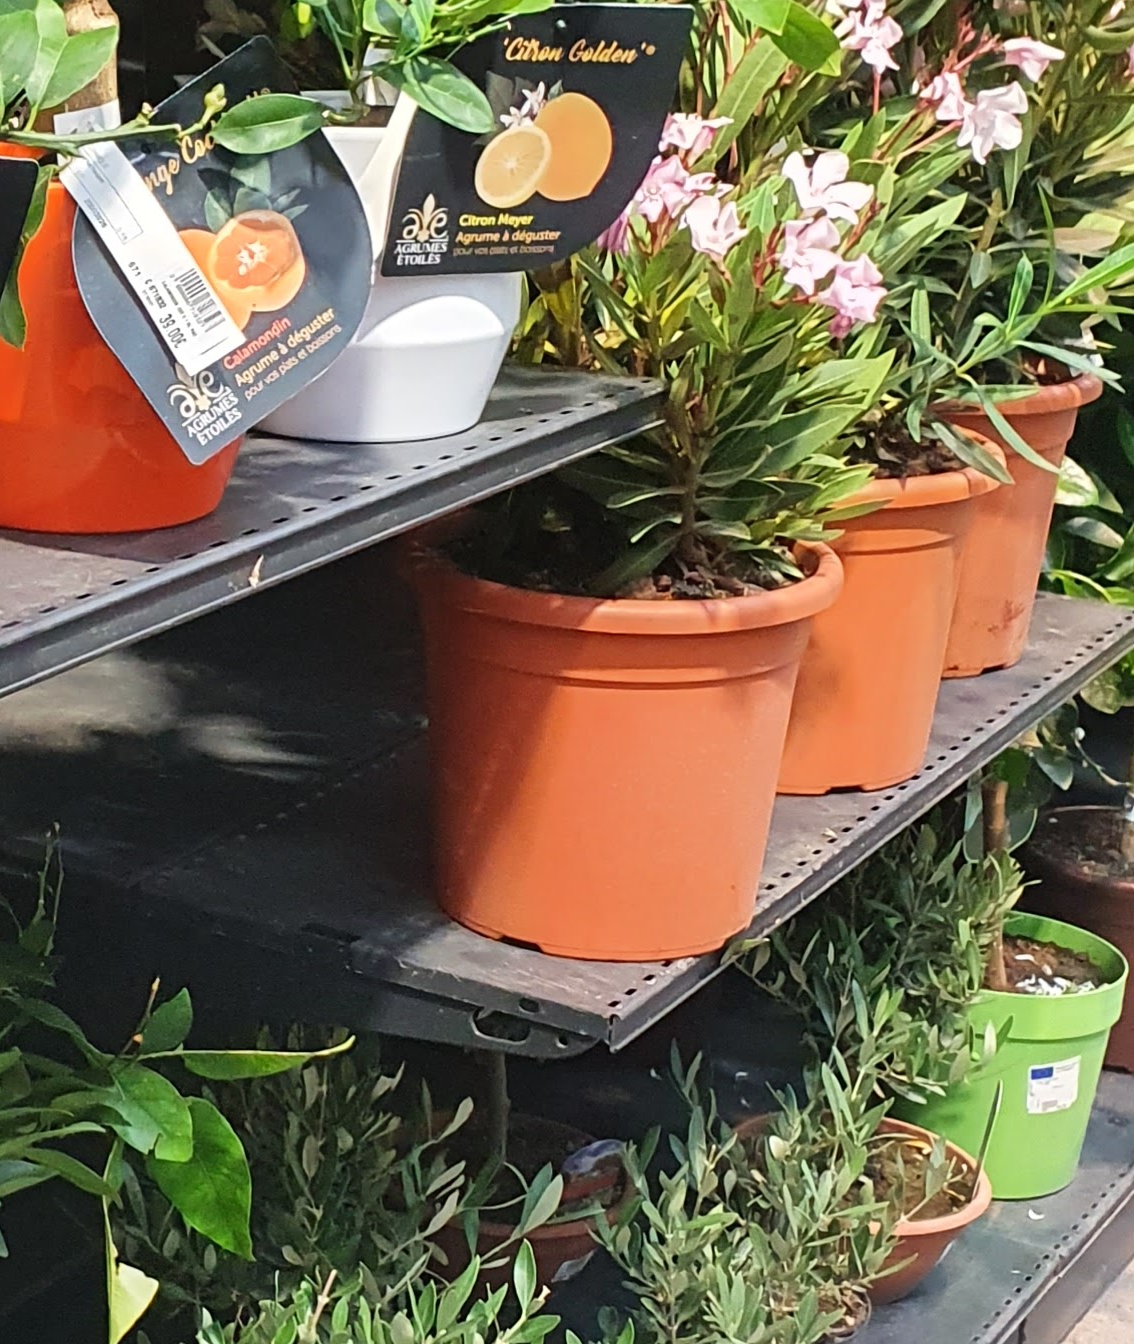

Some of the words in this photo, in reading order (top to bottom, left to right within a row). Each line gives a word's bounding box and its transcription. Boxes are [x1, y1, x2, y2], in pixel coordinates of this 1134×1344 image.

[459, 214, 496, 227] Citron
[498, 213, 533, 228] Meyer
[394, 242, 448, 254] AGRUMES
[455, 231, 499, 246] Agrume
[512, 230, 561, 246] déguster
[223, 316, 291, 370] Calamondin
[235, 350, 279, 387] Agrume
[278, 342, 289, 355] à
[287, 308, 336, 348] déguster
[186, 393, 239, 437] AGRUMES
